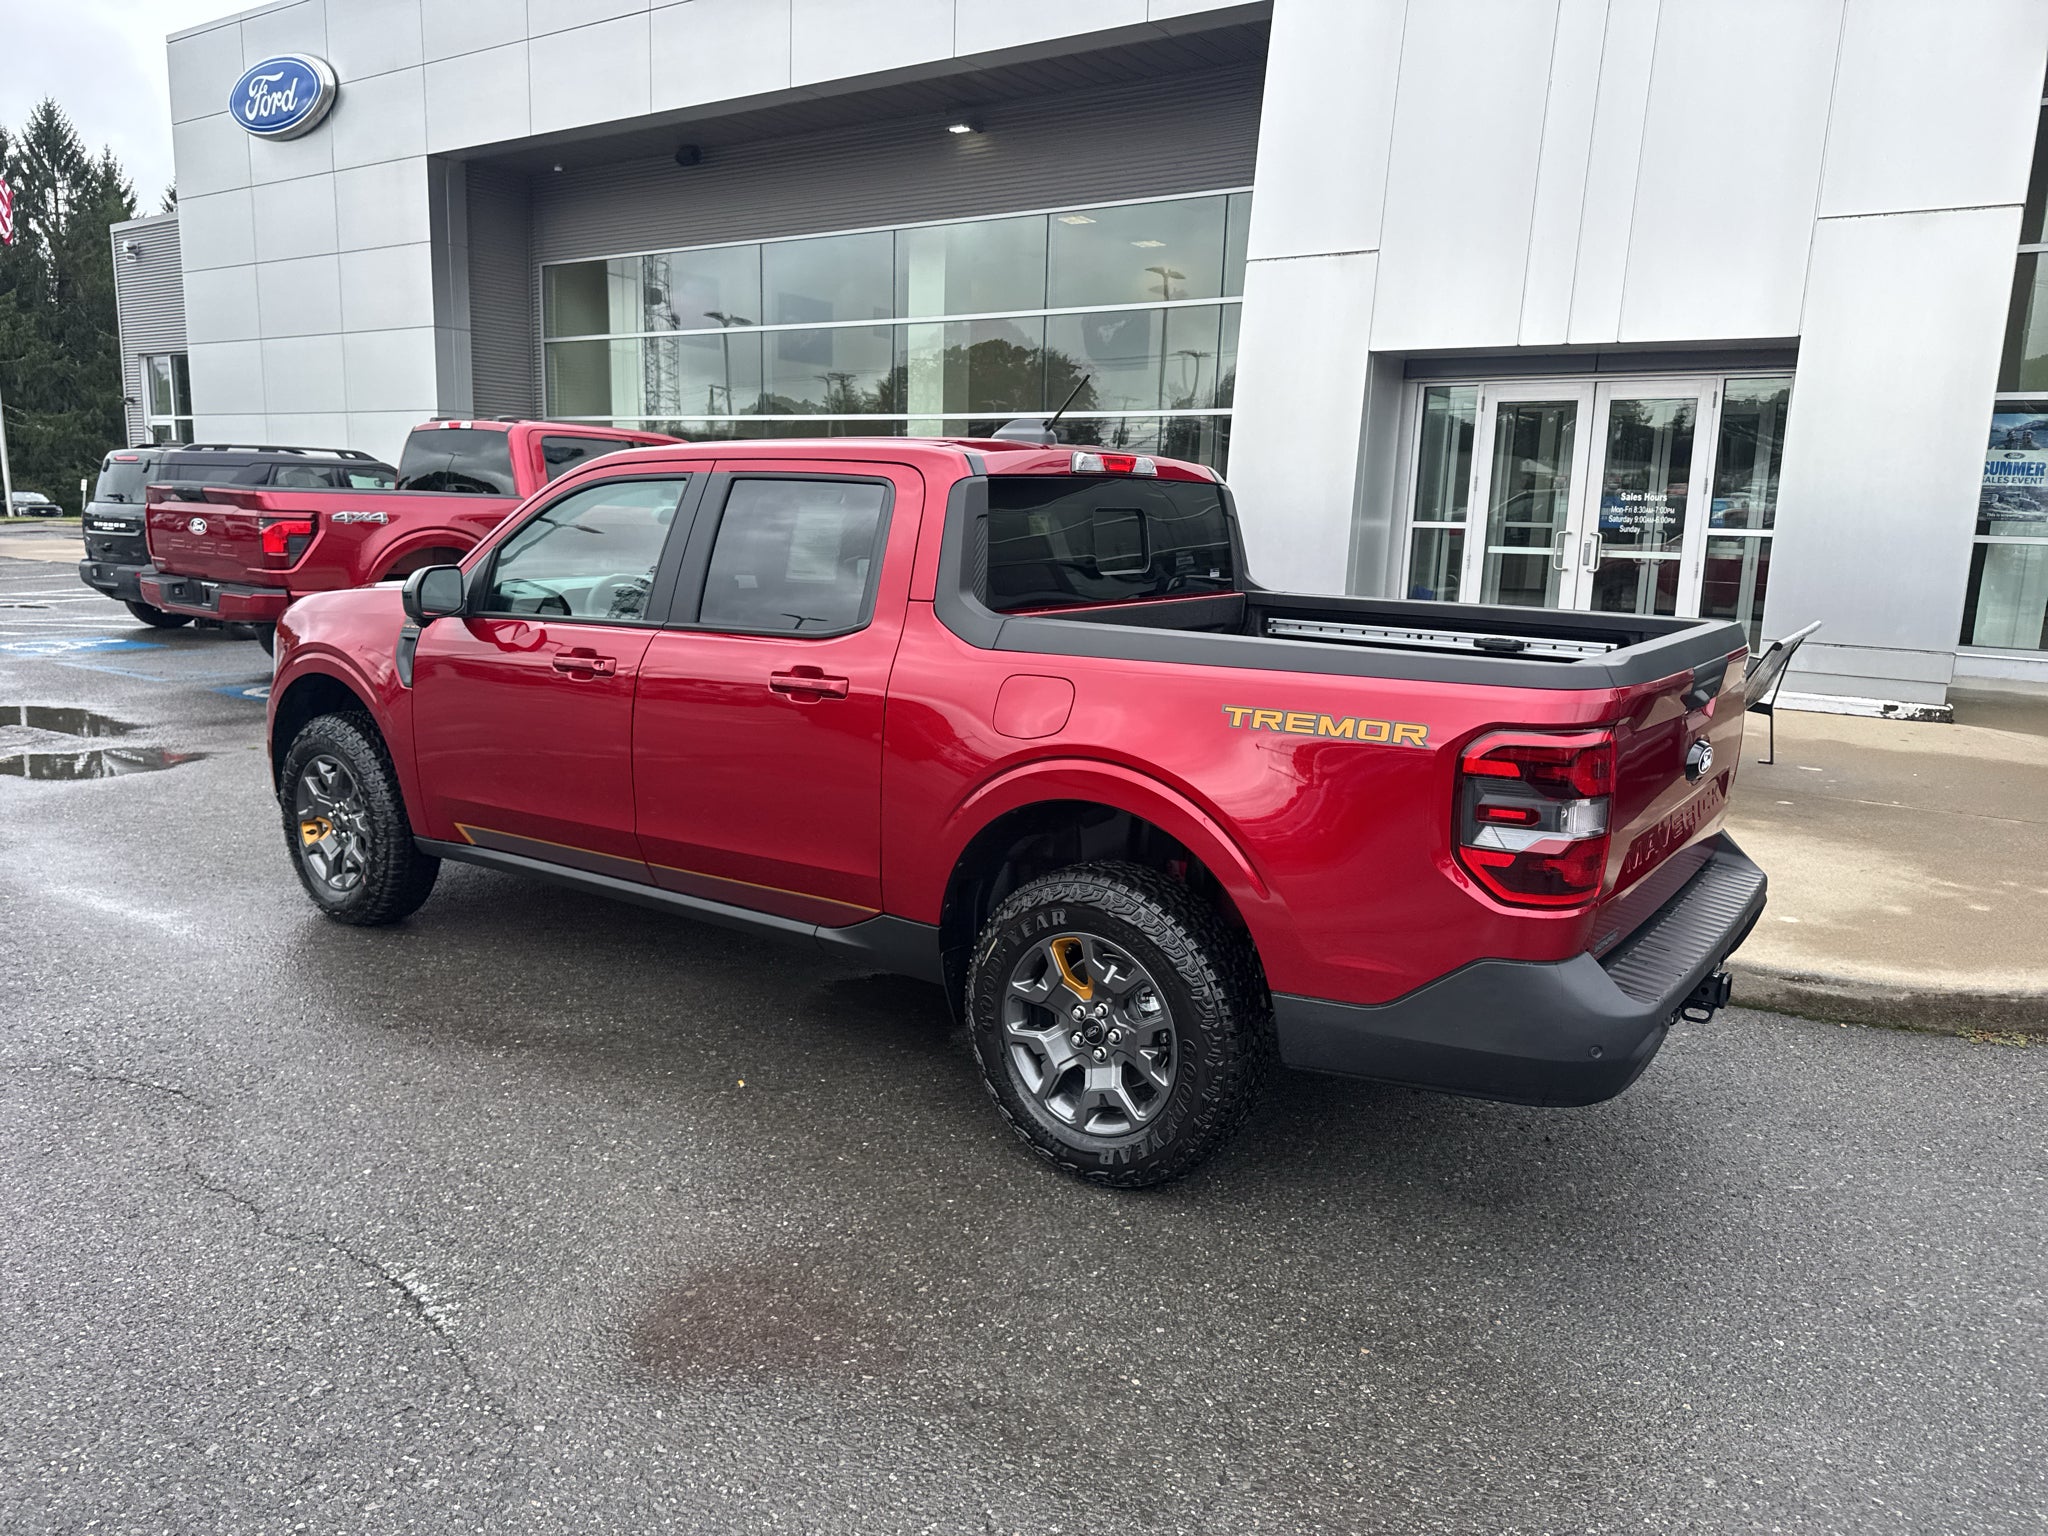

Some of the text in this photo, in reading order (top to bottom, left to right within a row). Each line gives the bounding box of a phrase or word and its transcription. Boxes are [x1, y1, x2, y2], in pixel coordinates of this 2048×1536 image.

[245, 71, 298, 121] Ford
[1620, 492, 1668, 501] Sales Hours
[1610, 505, 1633, 514] Mon-Fri
[1608, 515, 1633, 524] Saturday
[1619, 525, 1641, 534] Sunday
[1222, 704, 1430, 748] TREMOR
